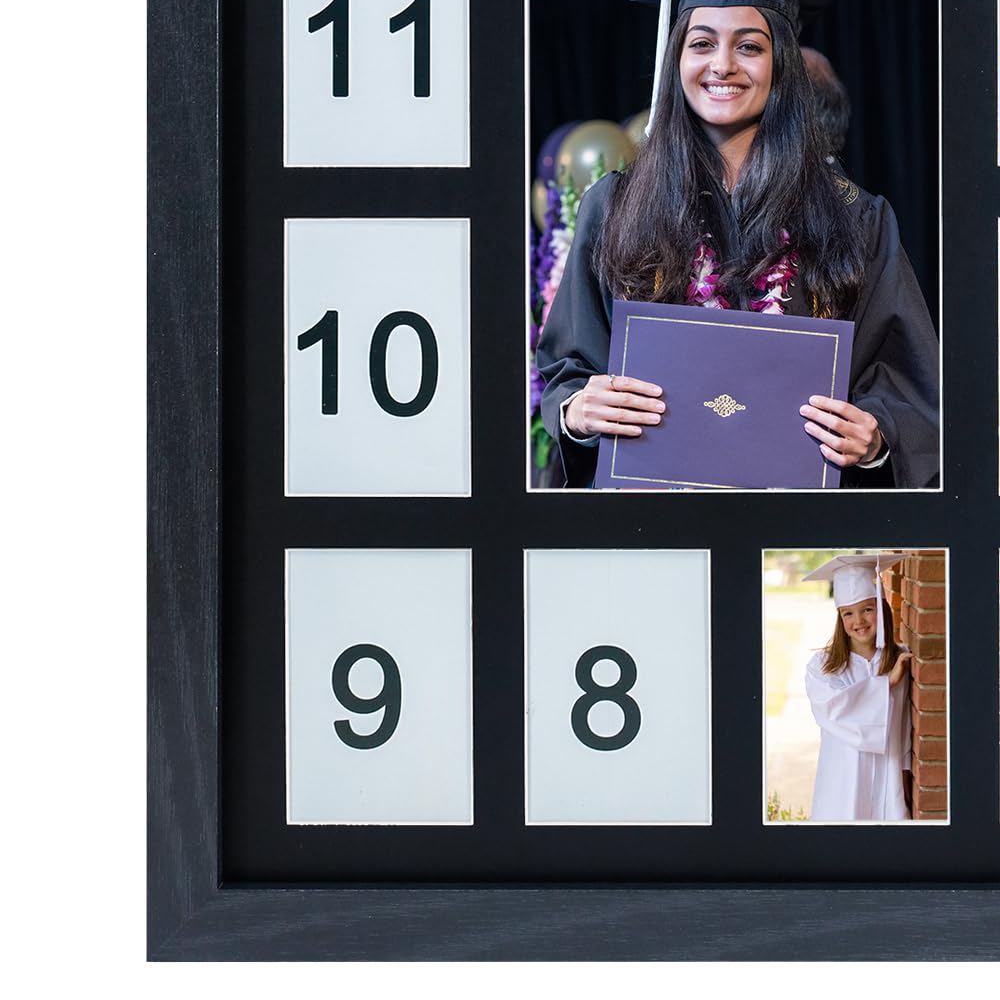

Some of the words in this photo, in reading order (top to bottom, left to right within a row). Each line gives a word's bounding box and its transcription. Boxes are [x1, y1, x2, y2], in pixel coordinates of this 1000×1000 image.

[297, 310, 439, 418] 10
[331, 643, 402, 750] 9
[570, 645, 642, 752] 8
